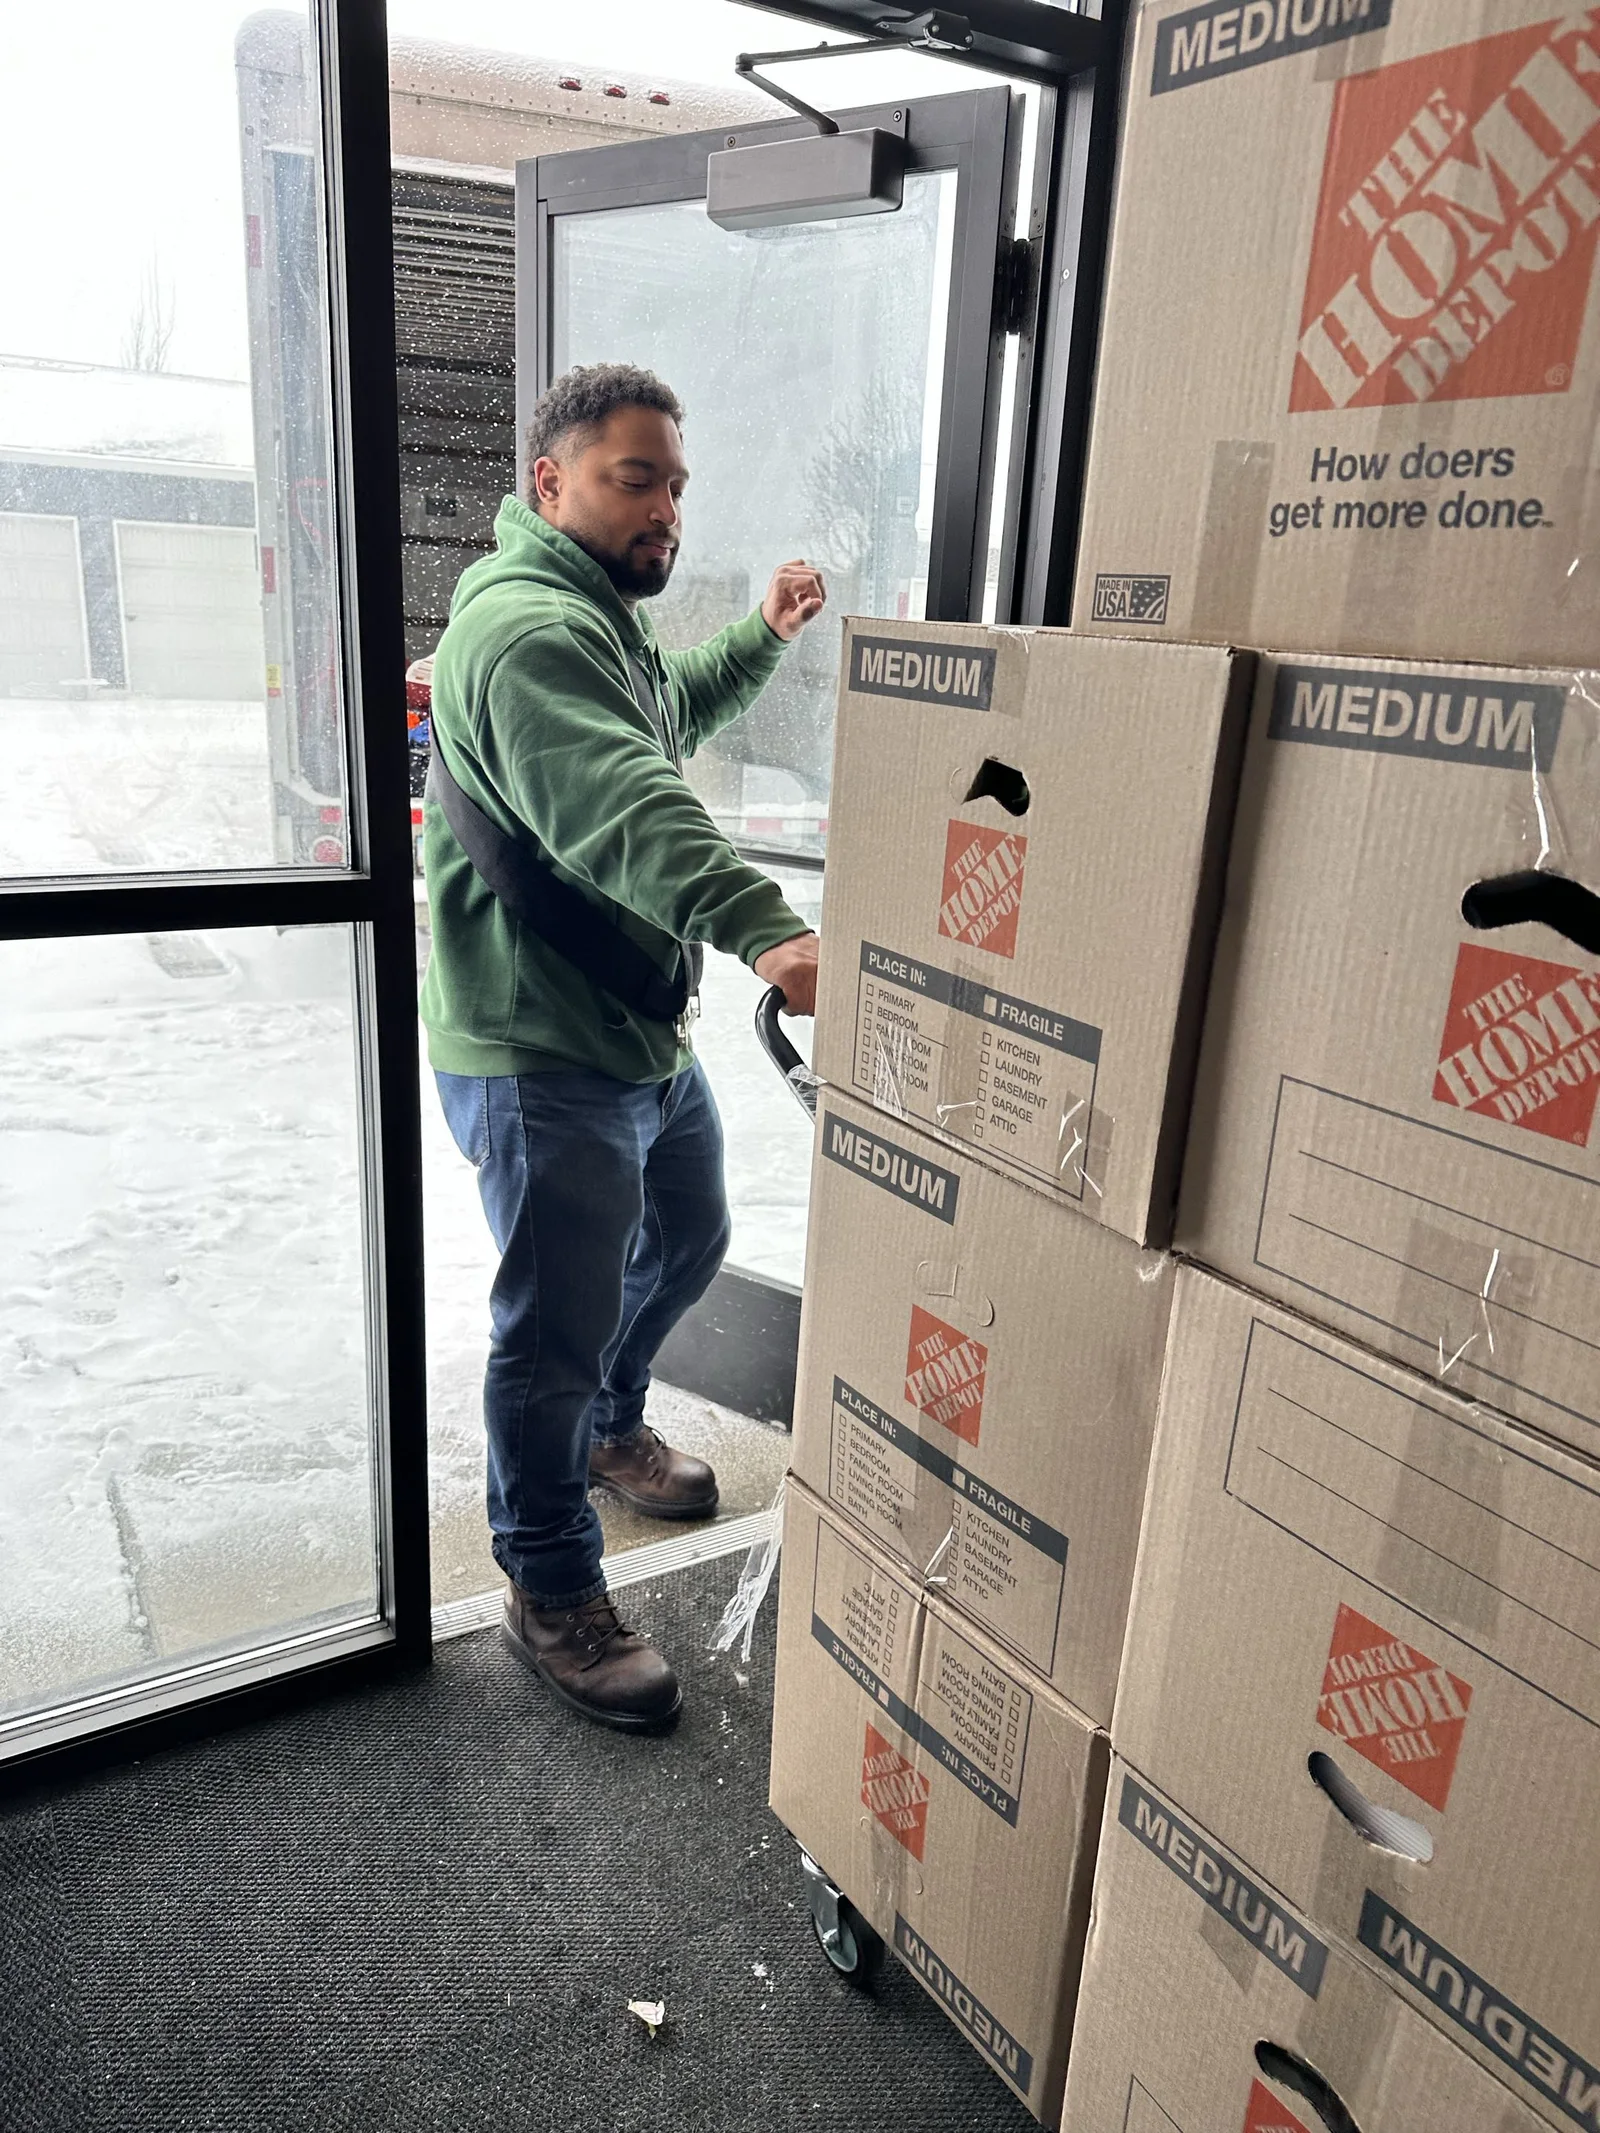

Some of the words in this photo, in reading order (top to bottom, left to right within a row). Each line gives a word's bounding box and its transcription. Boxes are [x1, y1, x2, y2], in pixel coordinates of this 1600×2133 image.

[1337, 87, 1467, 242] THE
[1393, 153, 1600, 401] DEPOT
[1310, 446, 1390, 482] How
[1400, 442, 1516, 480] doers
[1269, 496, 1324, 537] get
[1333, 499, 1427, 529] more
[1096, 590, 1127, 617] USA
[1099, 579, 1121, 591] MADE
[1122, 579, 1131, 591] IN
[860, 646, 982, 697] MEDIUM
[1290, 682, 1536, 754] MEDIUM
[951, 838, 986, 882] THE
[940, 834, 1026, 939] HOME
[967, 881, 1021, 947] DEPOT
[868, 951, 907, 979] PLACE
[910, 967, 927, 987] IN:
[877, 1006, 919, 1033] BEDROOM
[878, 989, 915, 1013] PRIMARY
[1462, 972, 1533, 1031] THE
[1000, 1002, 1064, 1041] FRAGILE
[995, 1057, 1042, 1086] LAUNDRY
[997, 1038, 1041, 1067] KITCHEN
[993, 1076, 1048, 1110] BASEMENT
[1494, 1038, 1600, 1123] DEPOT
[989, 1114, 1017, 1135] ATTIC
[991, 1095, 1033, 1124] GARAGE
[831, 1124, 946, 1210] MEDIUM
[915, 1330, 948, 1362] THE
[905, 1338, 986, 1409] HOME
[841, 1386, 878, 1425] PLACE
[880, 1416, 897, 1439] IN:
[932, 1380, 983, 1424] DEPOT
[850, 1439, 891, 1477] BEDROOM
[851, 1423, 887, 1457] PRIMARY
[849, 1453, 877, 1480] FAMILY
[878, 1472, 903, 1501] ROOM
[849, 1467, 874, 1494] LIVING
[875, 1486, 901, 1515] ROOM
[848, 1481, 875, 1509] DINING
[876, 1502, 902, 1531] ROOM
[848, 1495, 868, 1518] BATH
[969, 1481, 1032, 1535] FRAGILE
[966, 1526, 1012, 1566] LAUNDRY
[967, 1510, 1010, 1549] KITCHEN
[963, 1558, 1004, 1596] GARAGE
[965, 1542, 1018, 1588] BASEMENT
[962, 1574, 989, 1600] ATTIC
[845, 1613, 880, 1651] LAUNDRY
[847, 1629, 879, 1666] KITCHEN
[832, 1640, 876, 1693] FRAGILE
[941, 1650, 969, 1681] ROOM
[941, 1667, 969, 1698] ROOM
[981, 1666, 1006, 1694] BATH
[1328, 1640, 1416, 1686] DEPOT
[937, 1680, 966, 1713] ROOM
[971, 1674, 1004, 1710] DINING
[971, 1692, 1002, 1725] LIVING
[1318, 1668, 1469, 1742] HOME
[950, 1709, 998, 1756] BEDROOM
[967, 1706, 1000, 1741] FAMILY
[942, 1745, 959, 1766] IN:
[954, 1729, 996, 1772] PRIMARY
[1381, 1728, 1441, 1764] THE
[962, 1765, 1008, 1812] PLACE
[1134, 1796, 1309, 1973] MEDIUM
[904, 1929, 1019, 2075] MEDIUM
[1378, 1913, 1600, 2130] MEDIUM
